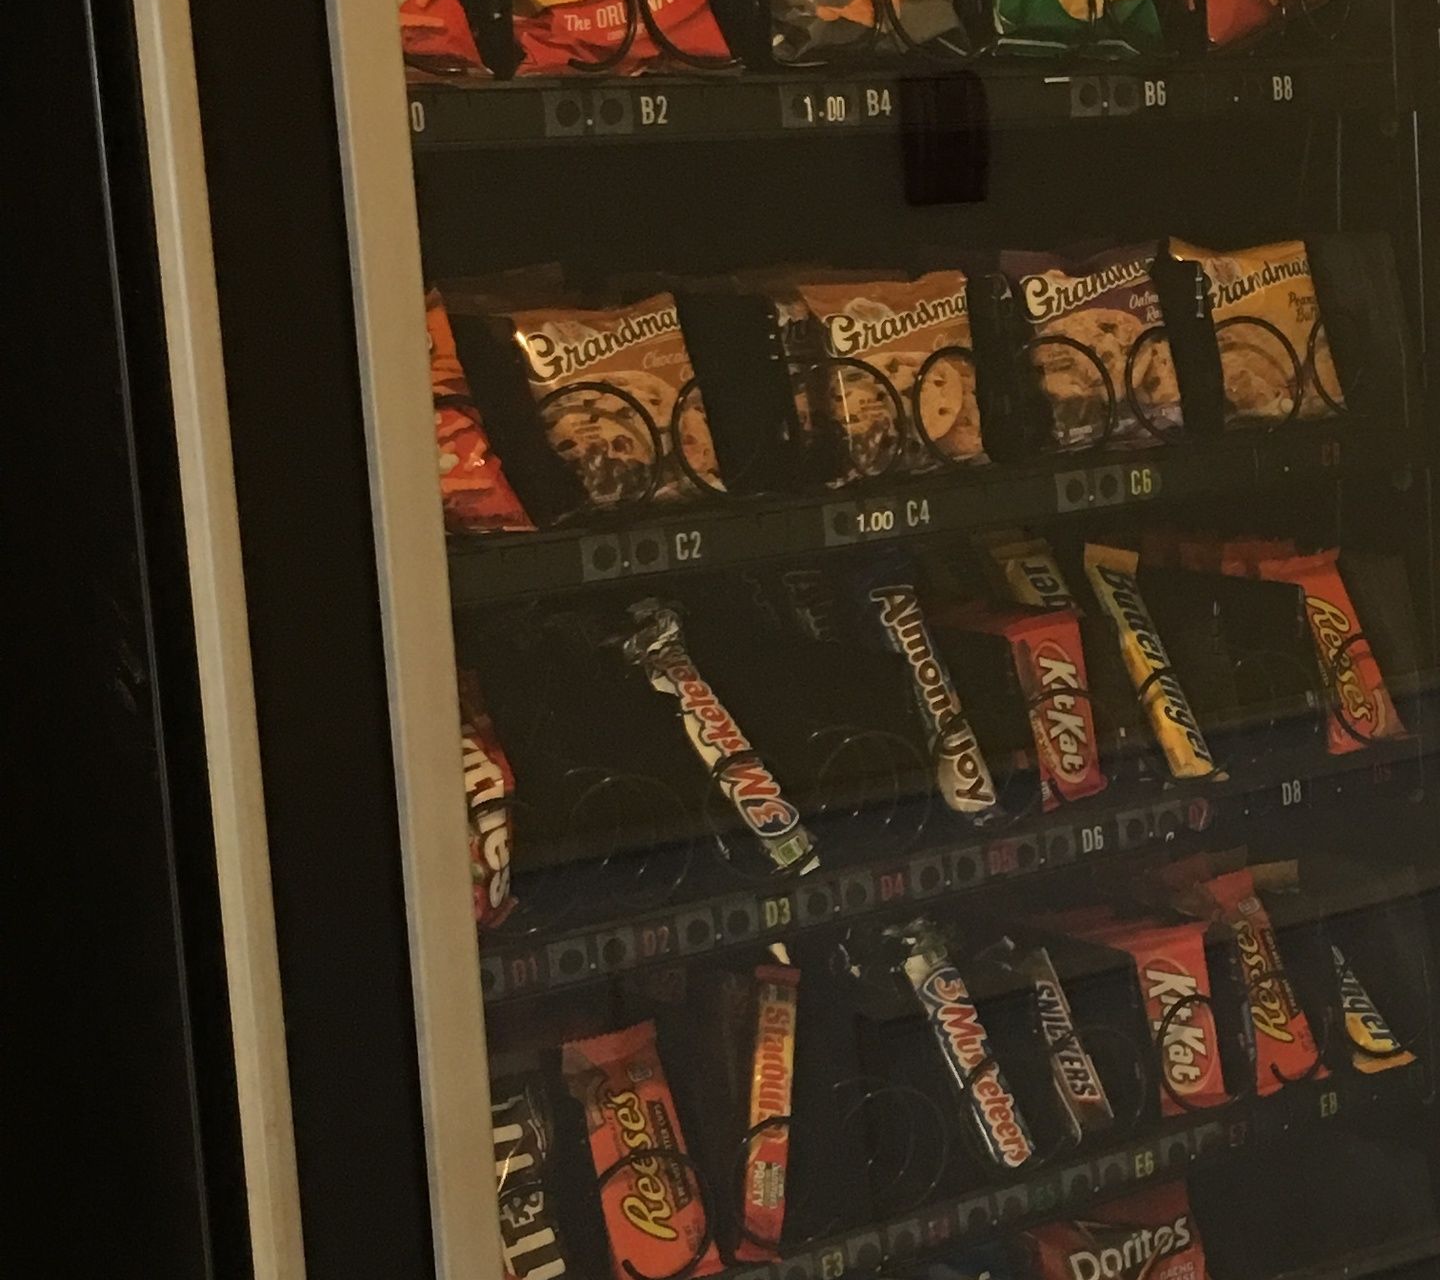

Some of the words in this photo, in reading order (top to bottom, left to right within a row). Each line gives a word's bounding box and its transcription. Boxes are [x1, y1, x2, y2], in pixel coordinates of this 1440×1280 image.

[564, 15, 591, 32] The
[1144, 80, 1166, 106] B6
[1272, 75, 1293, 101] B8
[640, 96, 668, 125] B2
[803, 96, 846, 122] 1.00
[867, 89, 892, 116] B4
[1130, 469, 1152, 496] C6
[856, 511, 895, 532] 1.00
[906, 499, 930, 527] C4
[675, 531, 701, 561] C2
[1282, 780, 1302, 806] D8
[746, 802, 791, 827] 3
[1082, 827, 1104, 854] D6
[765, 897, 791, 927] D3
[933, 975, 969, 1000] 3
[1134, 1151, 1155, 1178] E6
[821, 1252, 845, 1280] E3
